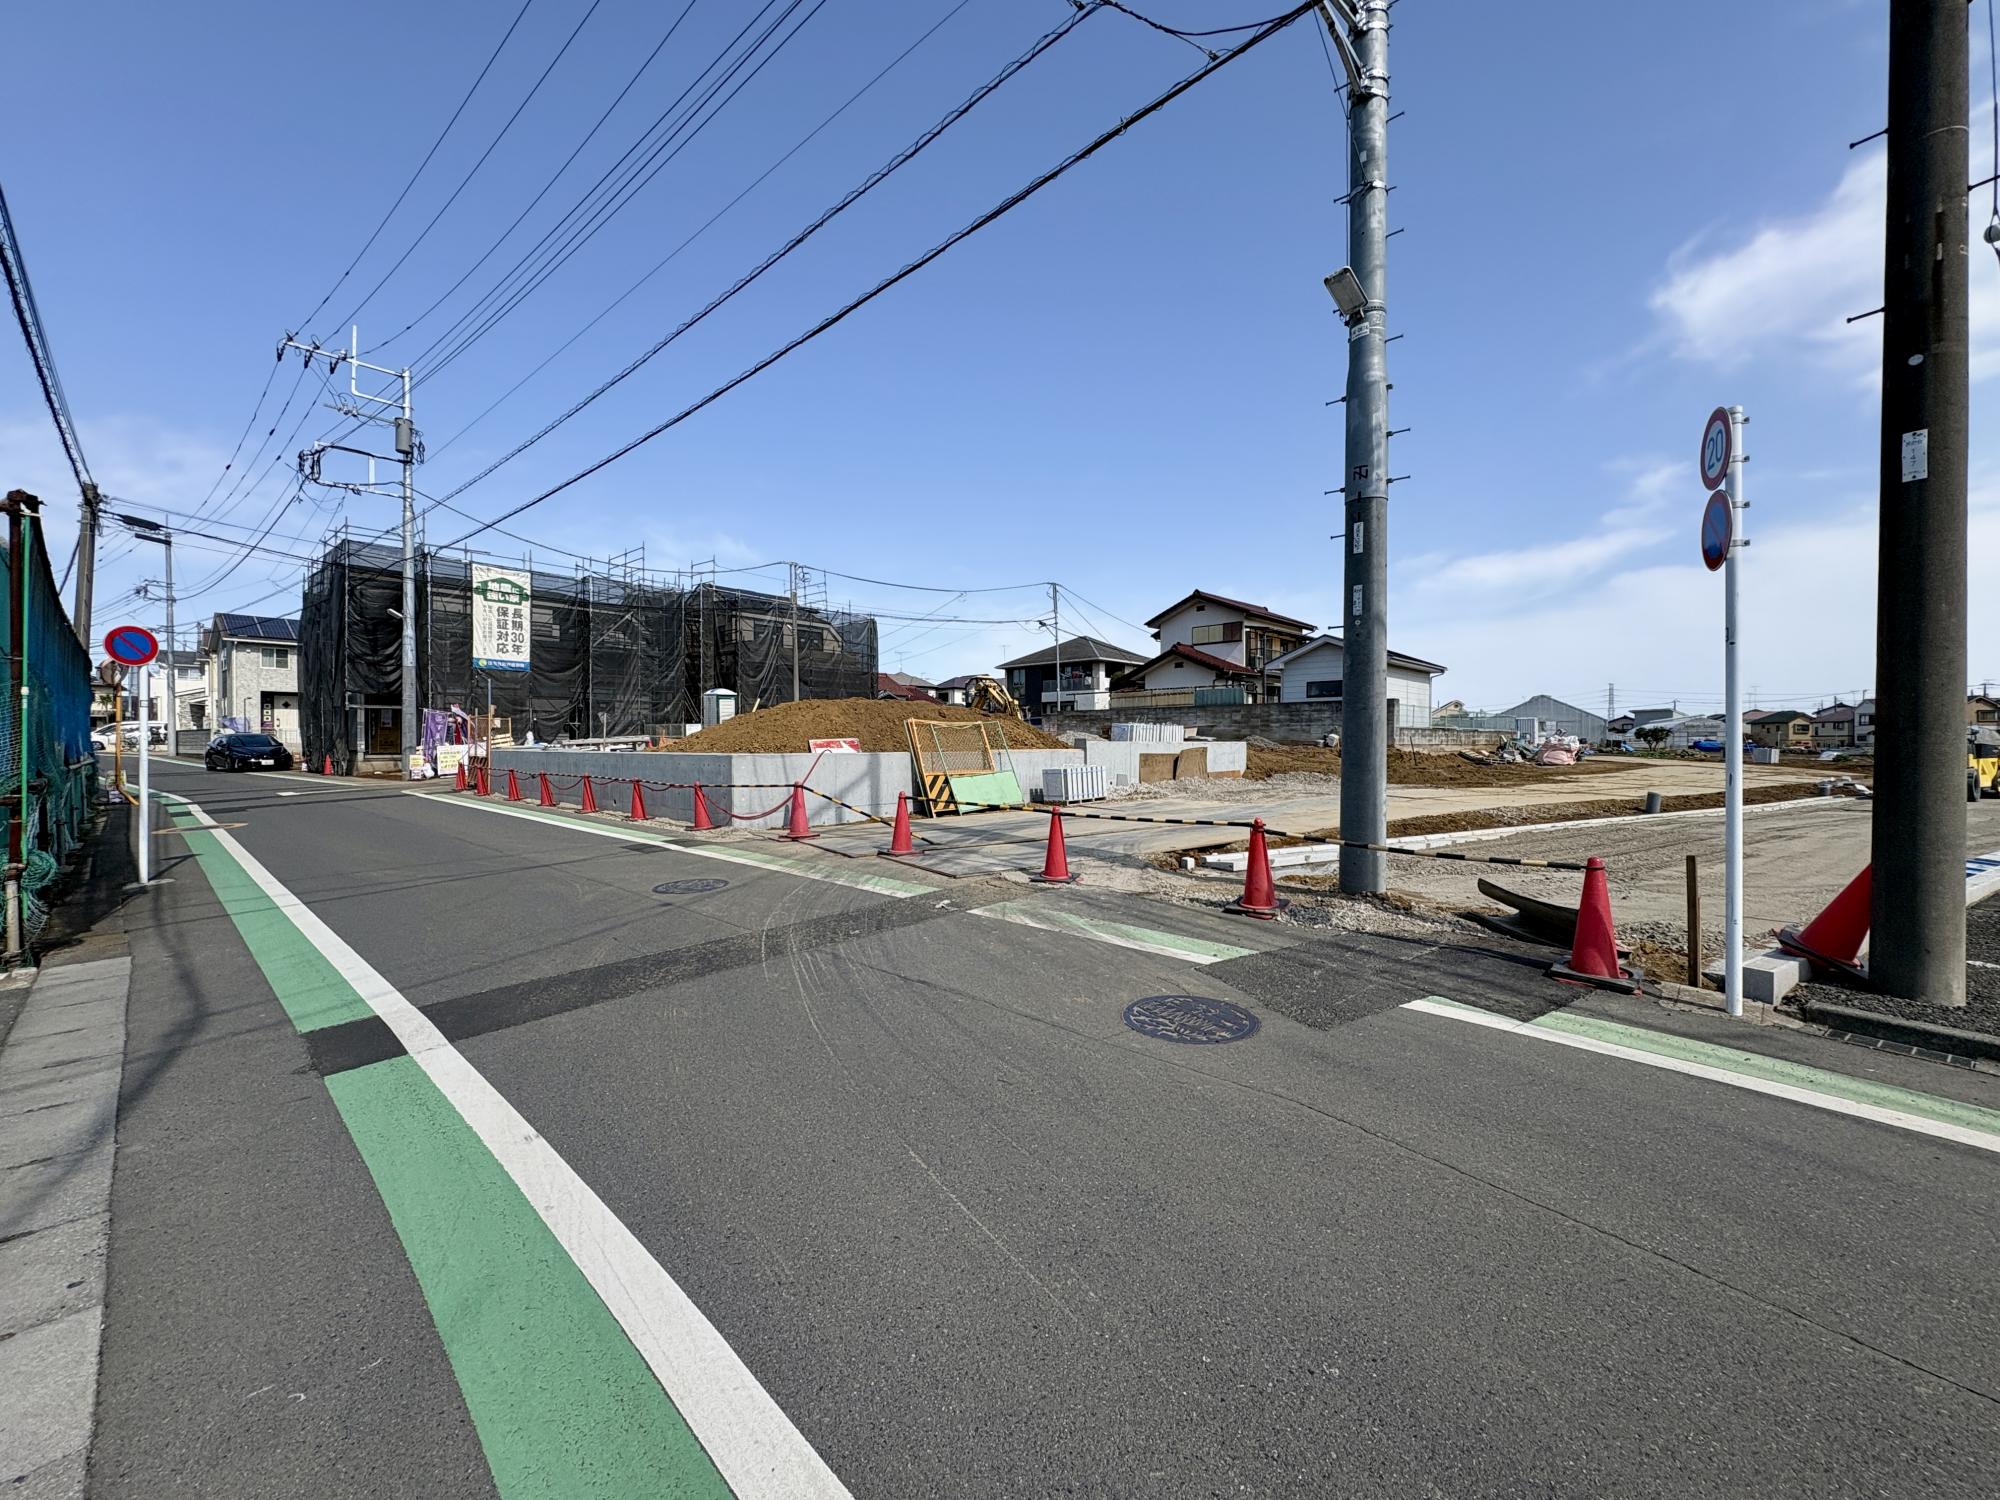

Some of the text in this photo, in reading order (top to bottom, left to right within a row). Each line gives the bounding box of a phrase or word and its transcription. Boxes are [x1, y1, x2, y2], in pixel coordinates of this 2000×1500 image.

[1707, 428, 1723, 471] 20
[496, 606, 509, 654] 保証対応
[511, 608, 524, 655] 長期30年
